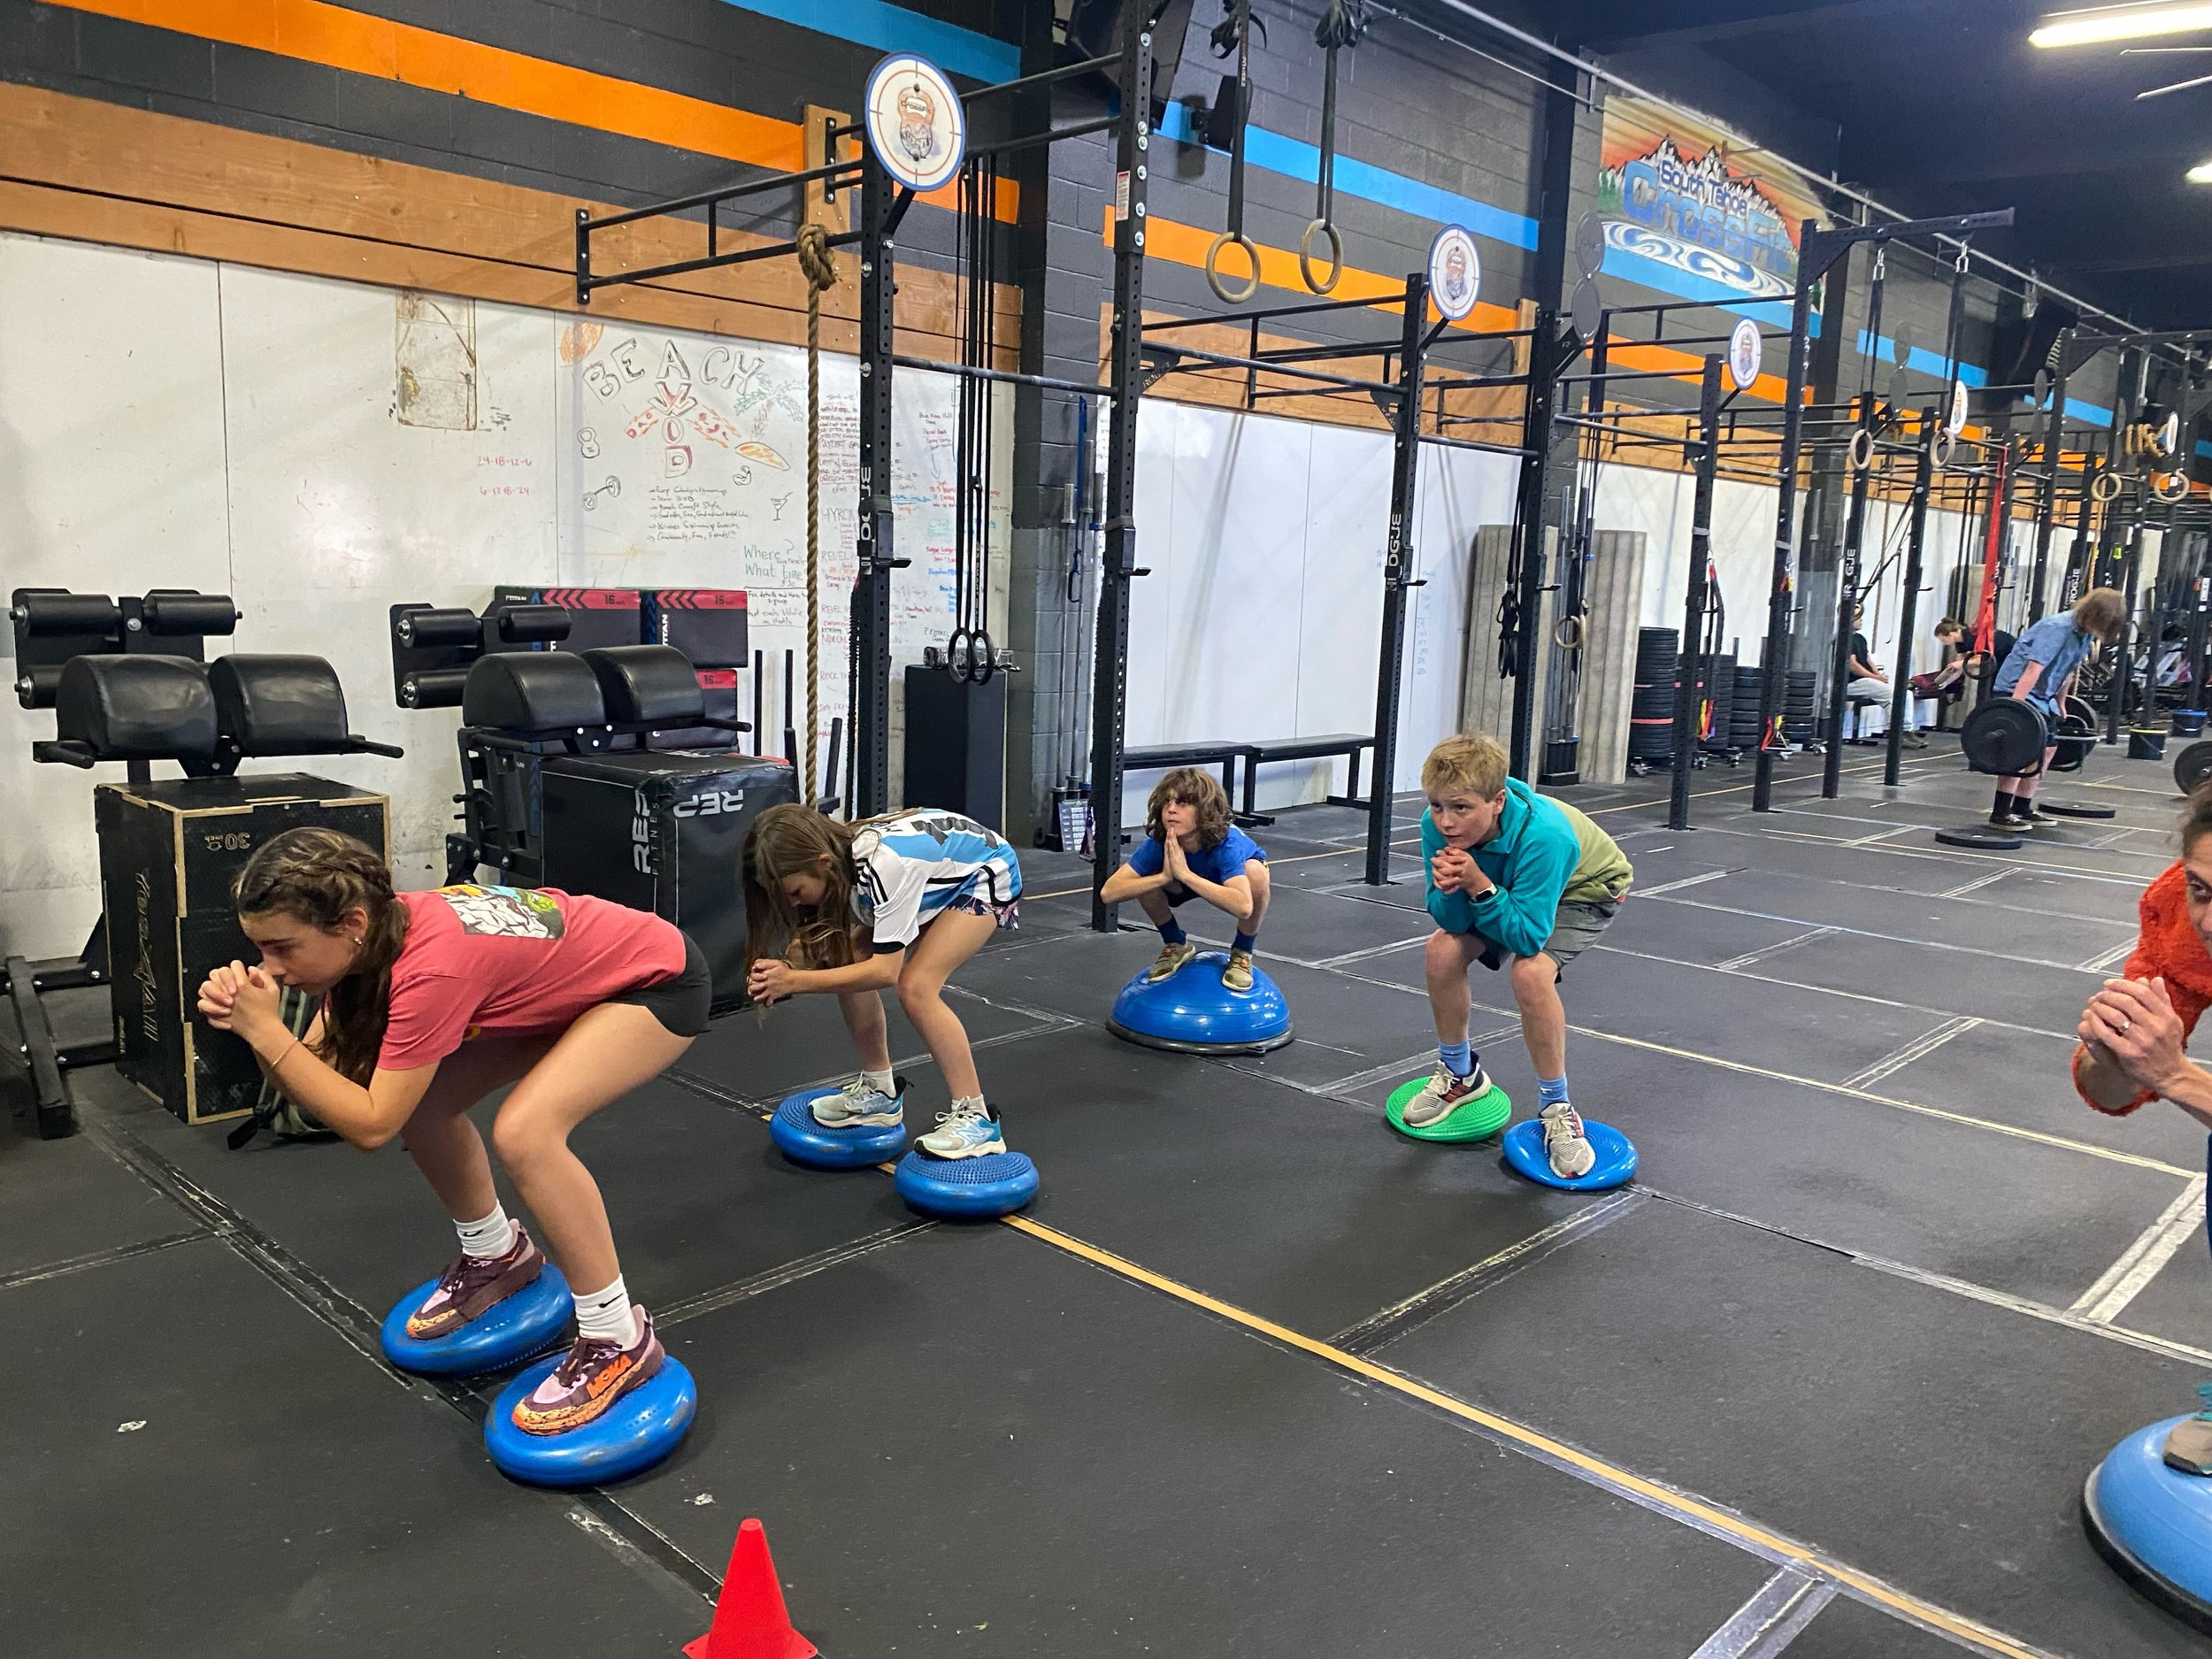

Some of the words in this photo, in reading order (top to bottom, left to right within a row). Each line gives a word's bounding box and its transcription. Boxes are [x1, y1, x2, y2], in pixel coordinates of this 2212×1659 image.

[1661, 160, 1705, 197] South
[1624, 160, 1793, 273] CrossFit
[582, 338, 764, 404] BEACH
[1388, 513, 1402, 567] OGUE
[745, 564, 776, 577] What
[1843, 549, 1855, 594] RGUE
[605, 594, 615, 604] 16
[715, 595, 725, 605] 16
[704, 674, 714, 685] 16
[672, 789, 743, 818] REP
[225, 833, 250, 850] 30
[633, 789, 651, 874] REP
[650, 796, 660, 875] FITNES
[587, 1355, 633, 1399] HOKA
